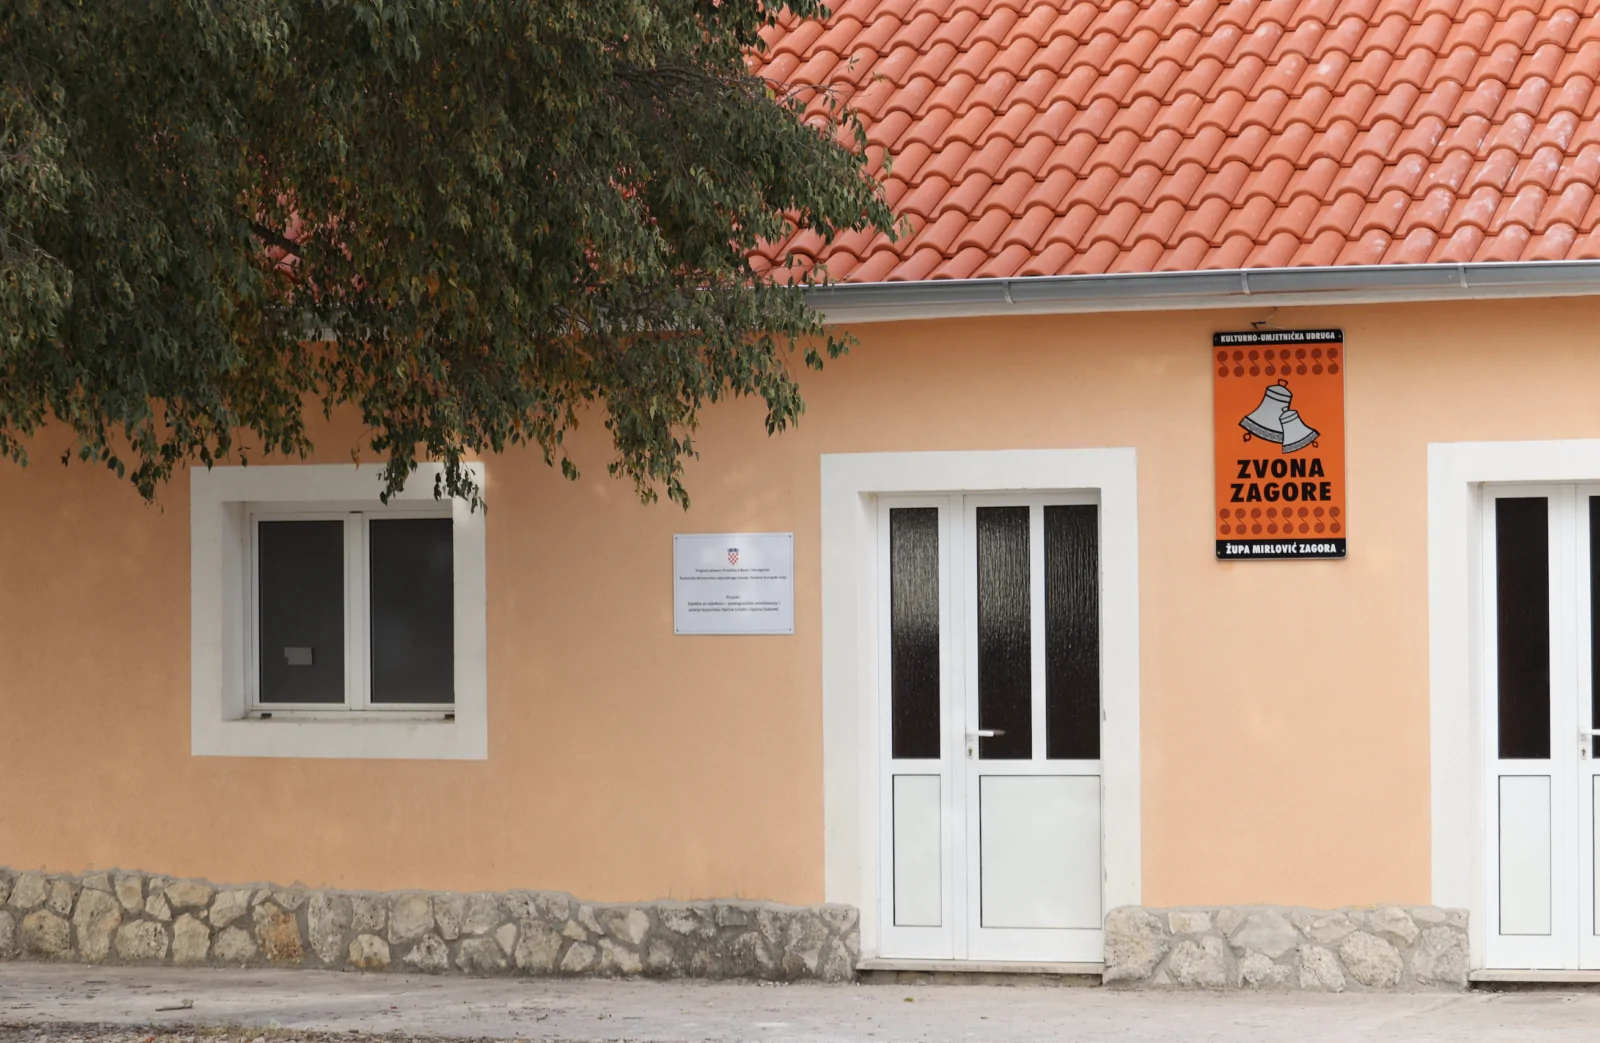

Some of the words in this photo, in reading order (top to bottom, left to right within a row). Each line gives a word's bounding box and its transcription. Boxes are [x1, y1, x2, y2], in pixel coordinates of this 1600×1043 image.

[1220, 331, 1305, 343] KULTURNO-UMJETNIČKA
[1306, 332, 1335, 340] UDRUGA
[1237, 458, 1325, 479] ZVONA
[1230, 482, 1331, 502] ZAGORE
[1226, 543, 1250, 554] ŽUPA
[1252, 542, 1297, 554] MIRLOVIĆ
[1299, 543, 1336, 553] ZAGORA
